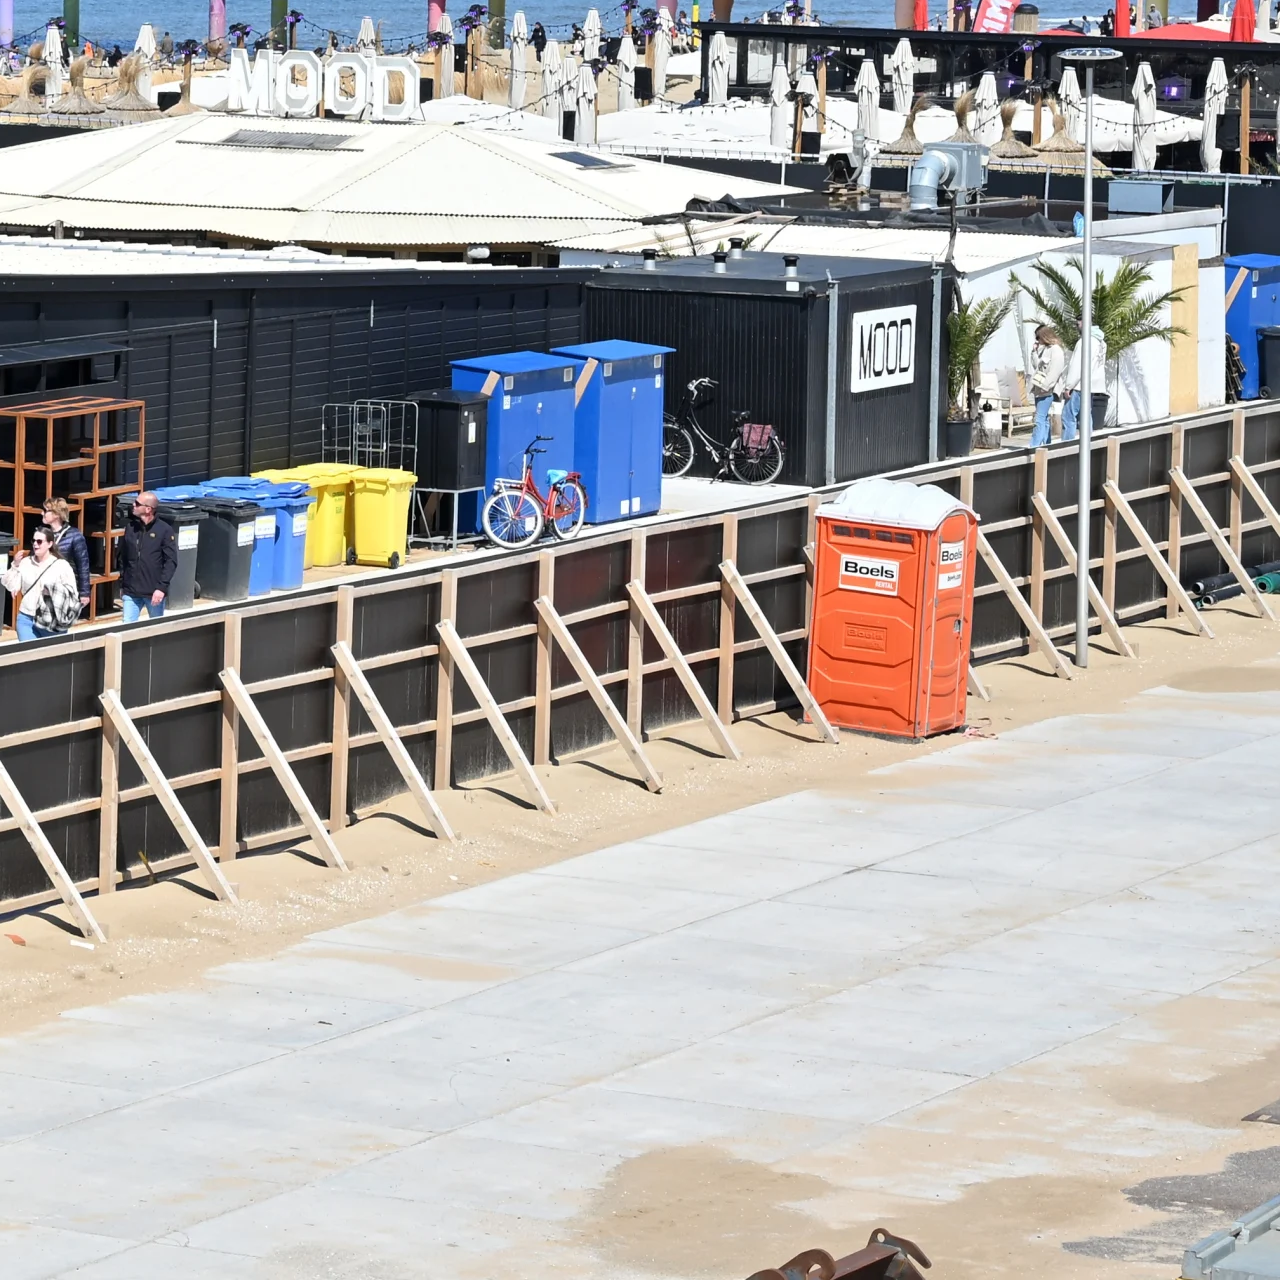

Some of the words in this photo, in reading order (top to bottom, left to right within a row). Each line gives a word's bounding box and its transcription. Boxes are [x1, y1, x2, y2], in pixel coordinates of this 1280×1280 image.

[228, 48, 421, 119] MOOD
[859, 318, 912, 380] MOOD
[942, 548, 962, 561] Boels
[845, 560, 894, 579] Boels
[875, 580, 893, 590] RENTAL
